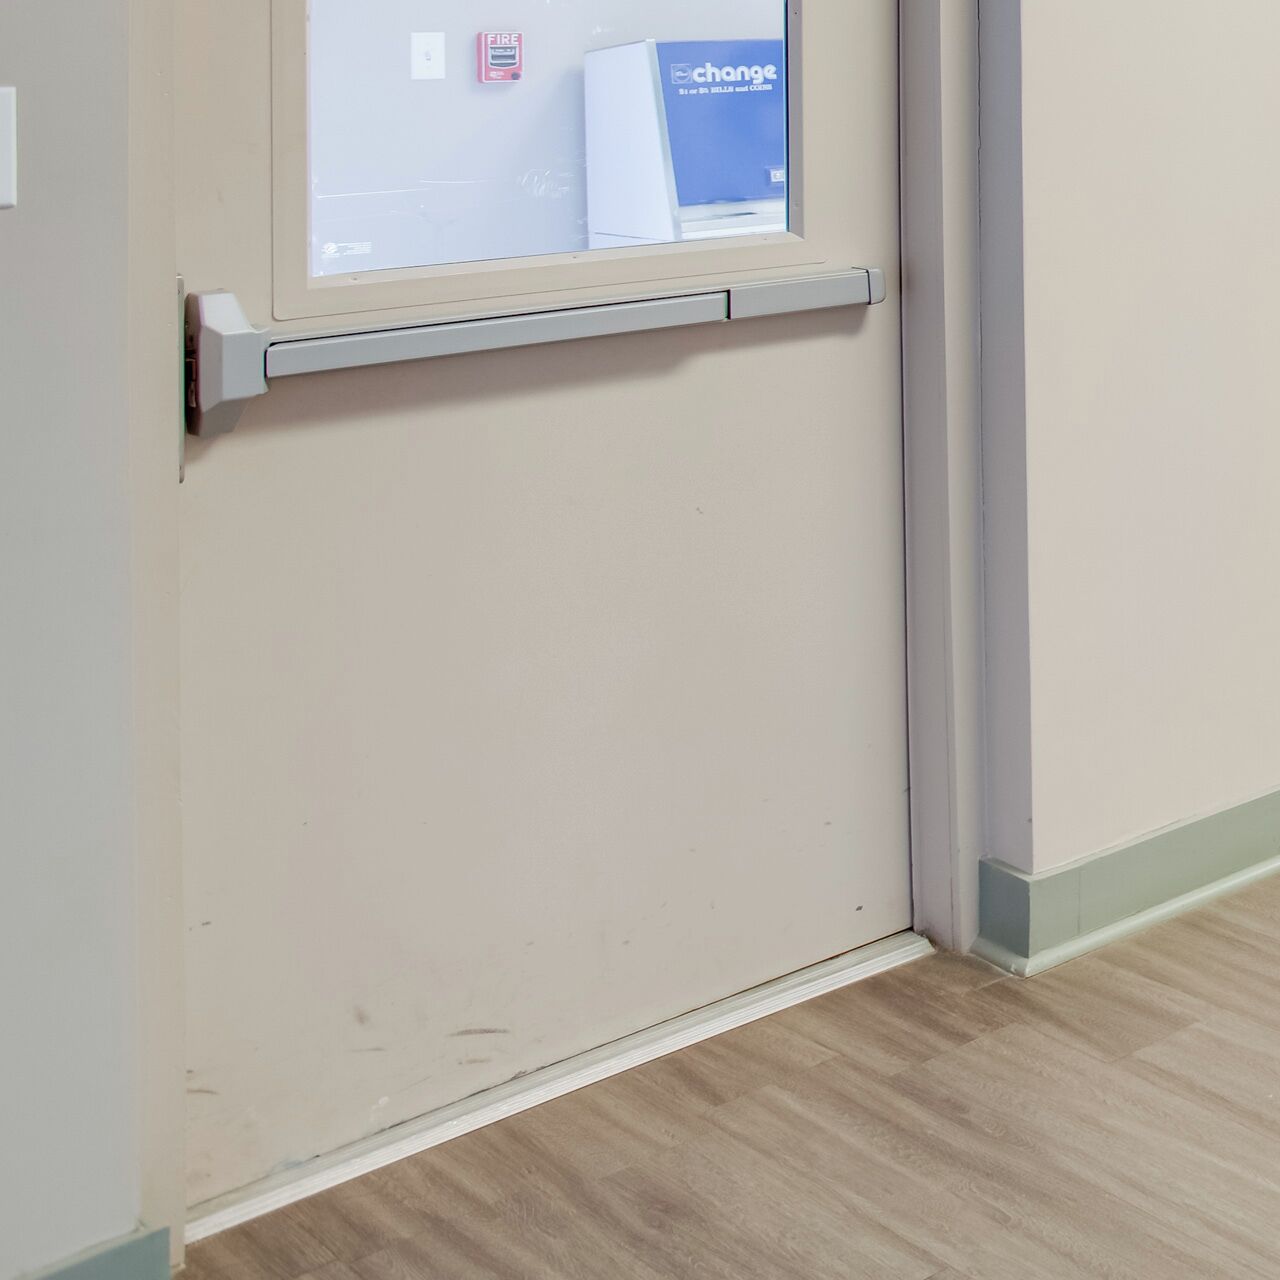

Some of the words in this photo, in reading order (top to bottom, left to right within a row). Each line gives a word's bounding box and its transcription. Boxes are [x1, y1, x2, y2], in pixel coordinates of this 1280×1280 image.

[488, 34, 519, 45] FIRE
[692, 62, 777, 85] change
[711, 86, 734, 94] BILLS
[749, 84, 773, 92] COINS
